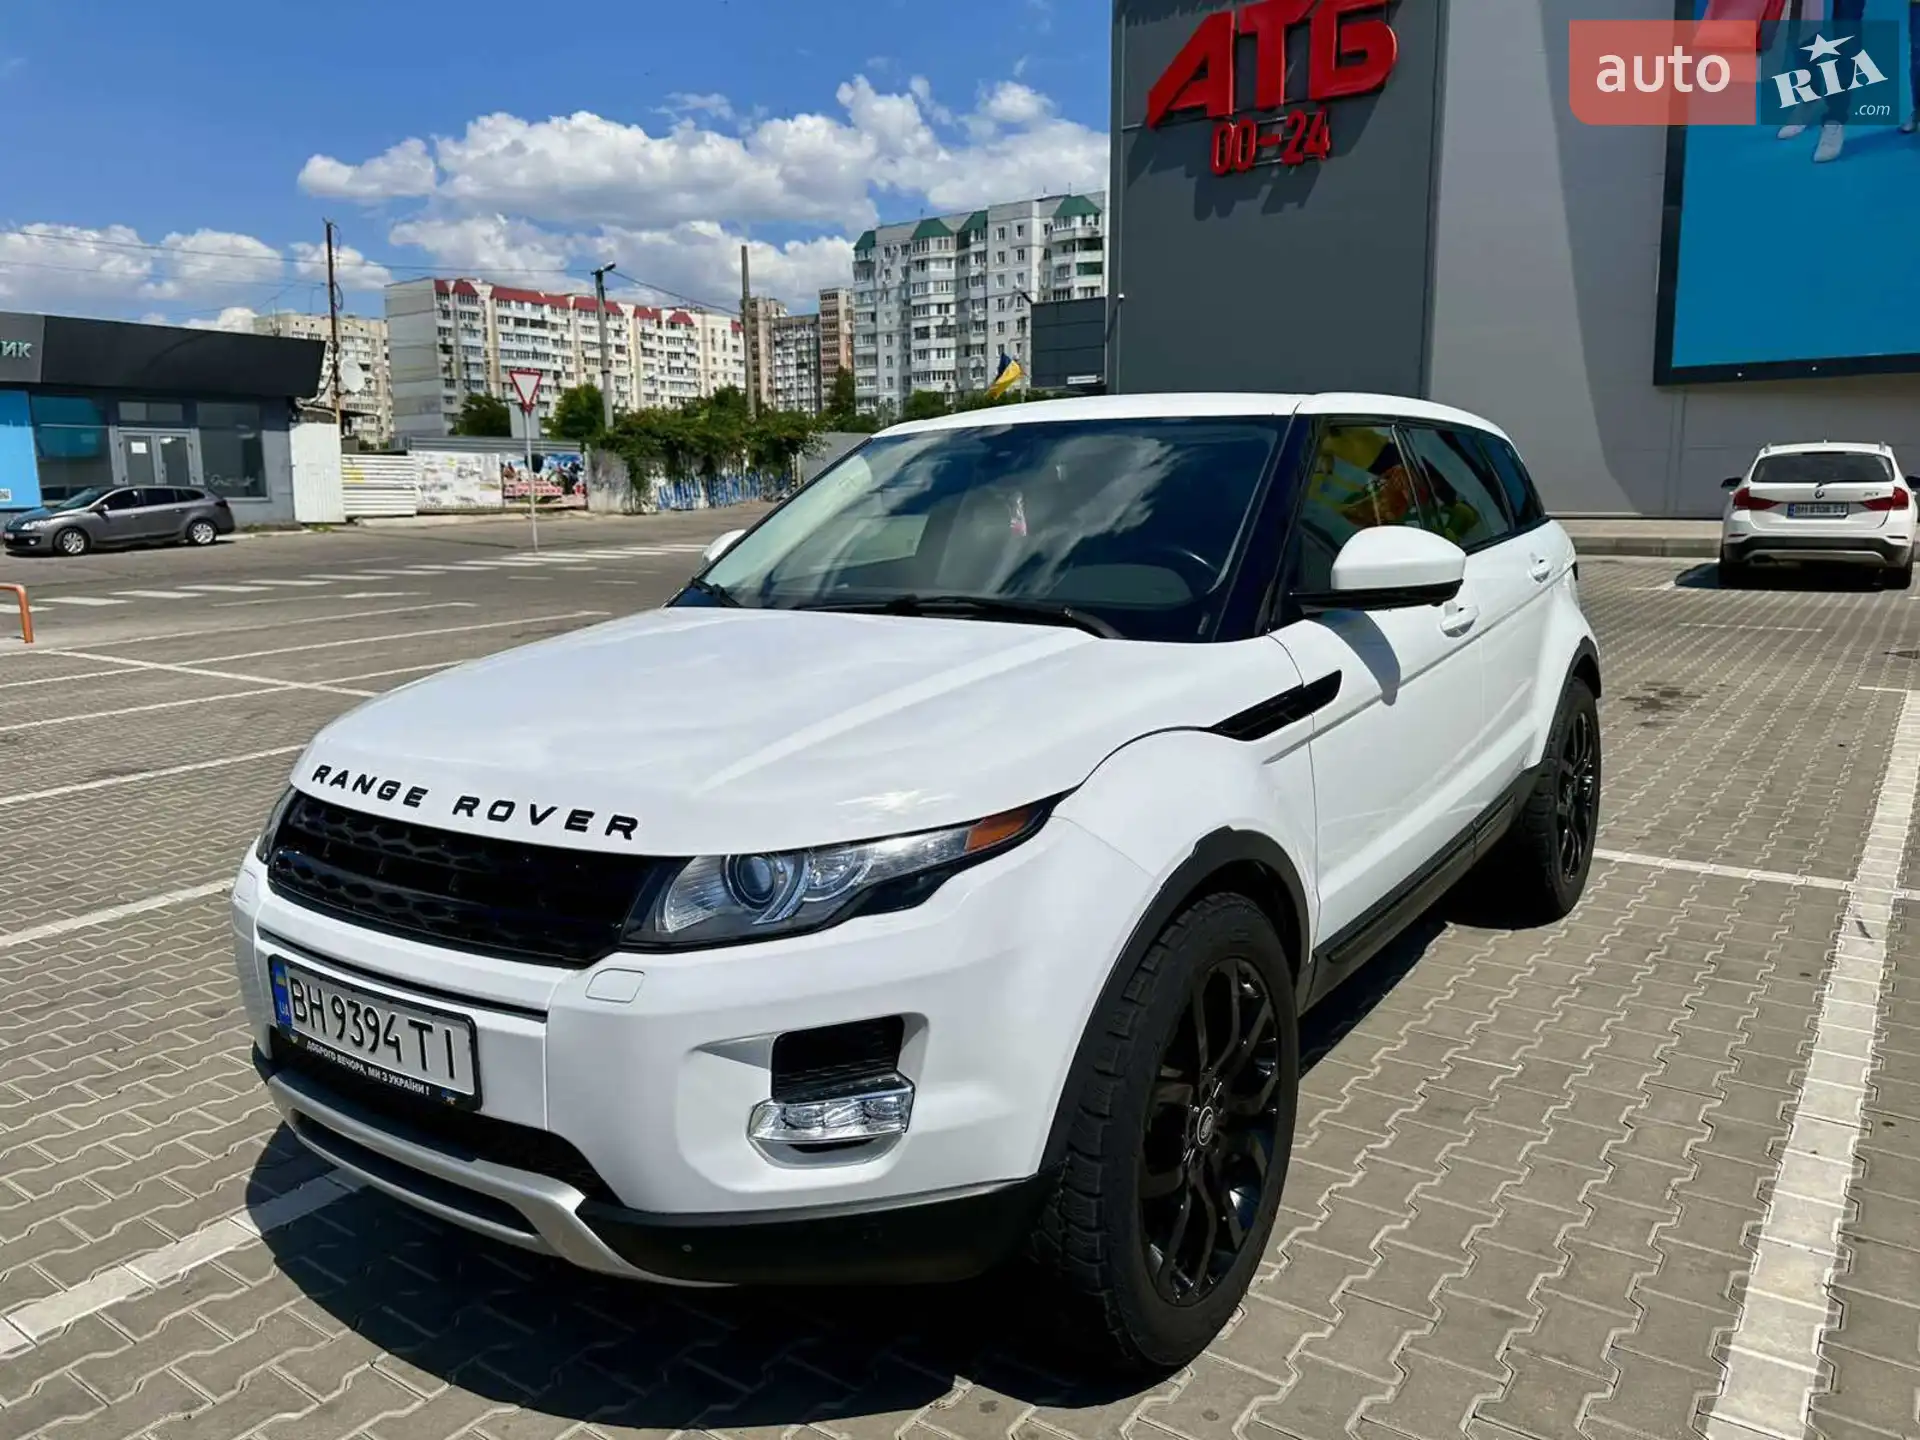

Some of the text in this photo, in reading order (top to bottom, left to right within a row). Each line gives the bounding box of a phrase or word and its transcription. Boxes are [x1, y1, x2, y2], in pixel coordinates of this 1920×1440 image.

[1146, 0, 1398, 130] АТБ
[1210, 106, 1331, 176] 00-24
[311, 764, 639, 841] RANGE ROVER
[306, 1040, 336, 1061] ДОБРОГО
[337, 1054, 366, 1075] ВЕЧОРА,
[332, 994, 402, 1063] 9394
